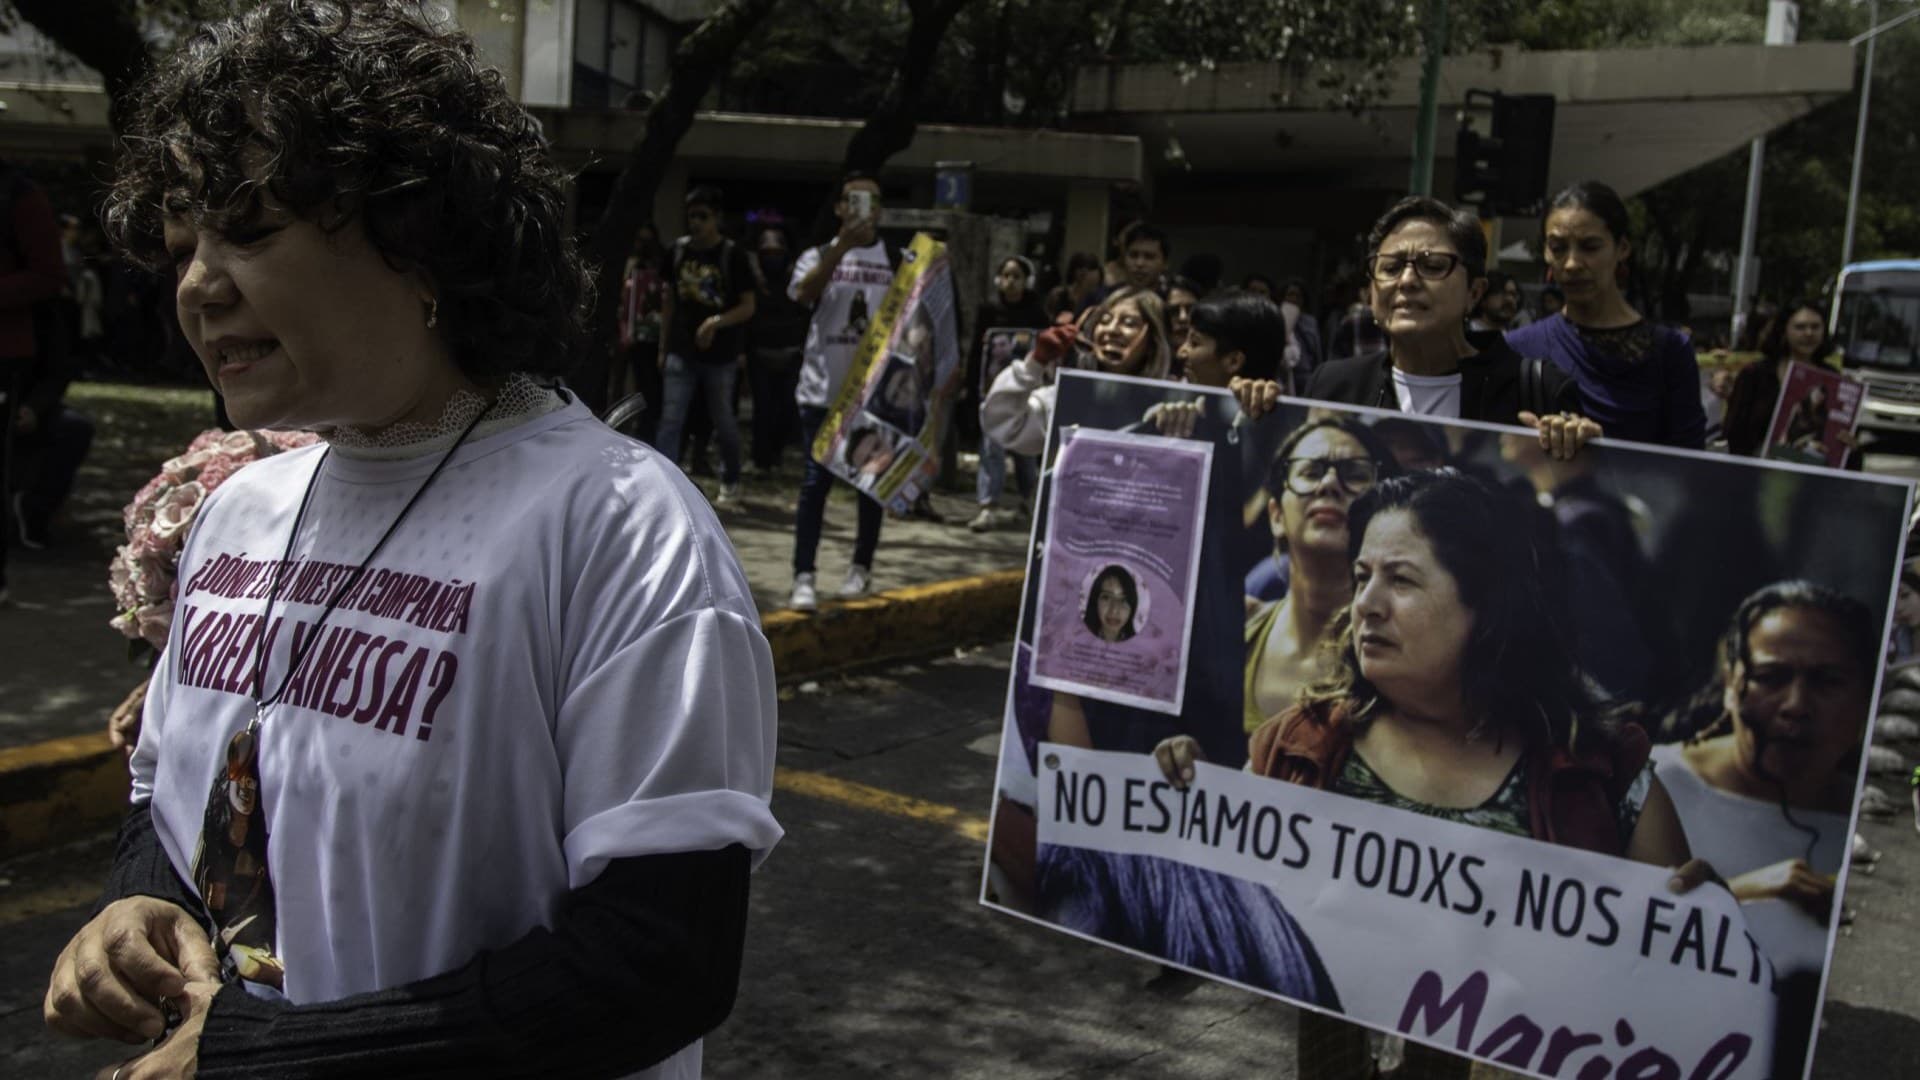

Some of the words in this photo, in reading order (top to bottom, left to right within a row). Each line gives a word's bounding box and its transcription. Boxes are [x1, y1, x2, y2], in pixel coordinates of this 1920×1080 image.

[358, 568, 476, 634] COMPAÑEA
[277, 620, 458, 742] VANESSA?
[1053, 770, 1106, 826] NO
[1122, 778, 1312, 870] ESTAMOS
[1331, 823, 1497, 928] TODXS,
[1514, 868, 1623, 948] NOS
[1640, 896, 1776, 994] FALT
